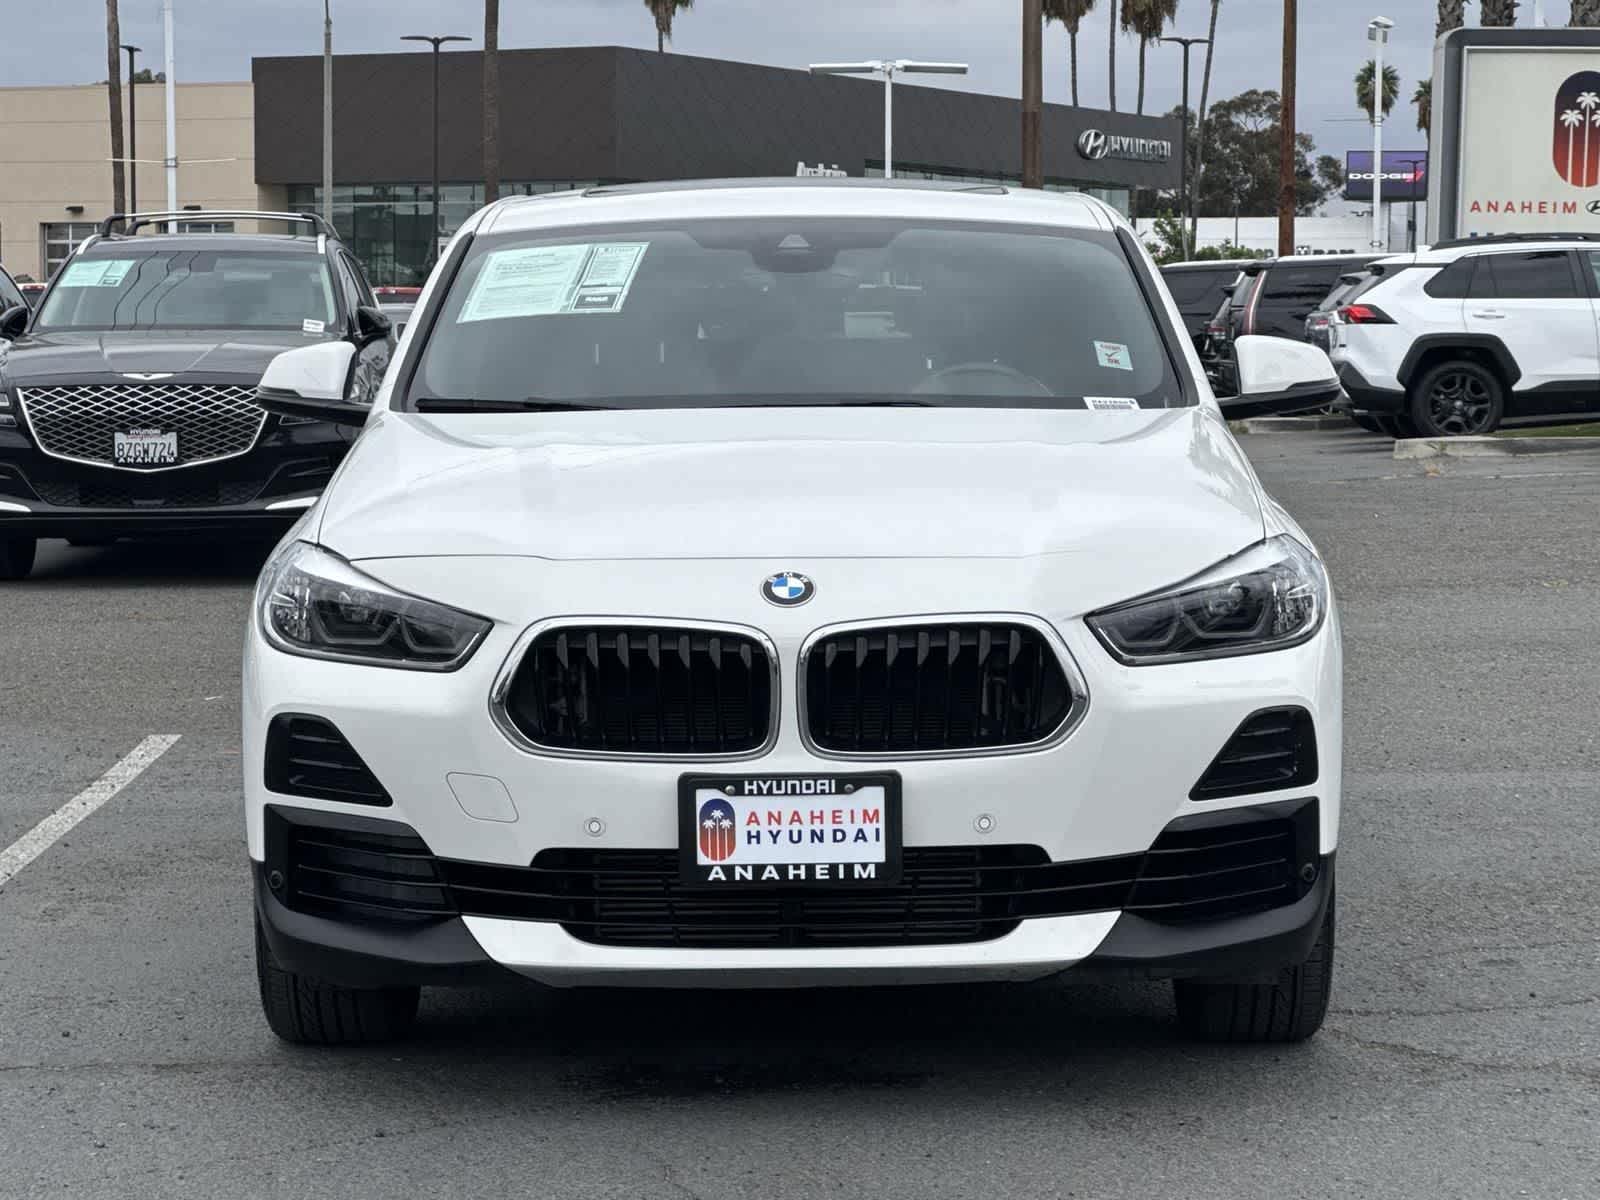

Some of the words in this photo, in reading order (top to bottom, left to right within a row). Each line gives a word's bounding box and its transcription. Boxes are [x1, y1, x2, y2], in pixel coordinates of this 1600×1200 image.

[1470, 200, 1577, 214] ANAHEIM
[744, 779, 836, 795] HYUNDAI
[746, 808, 880, 826] ANAHEIM
[746, 827, 881, 845] HYUNDAI
[707, 863, 876, 881] ANAHEIM
